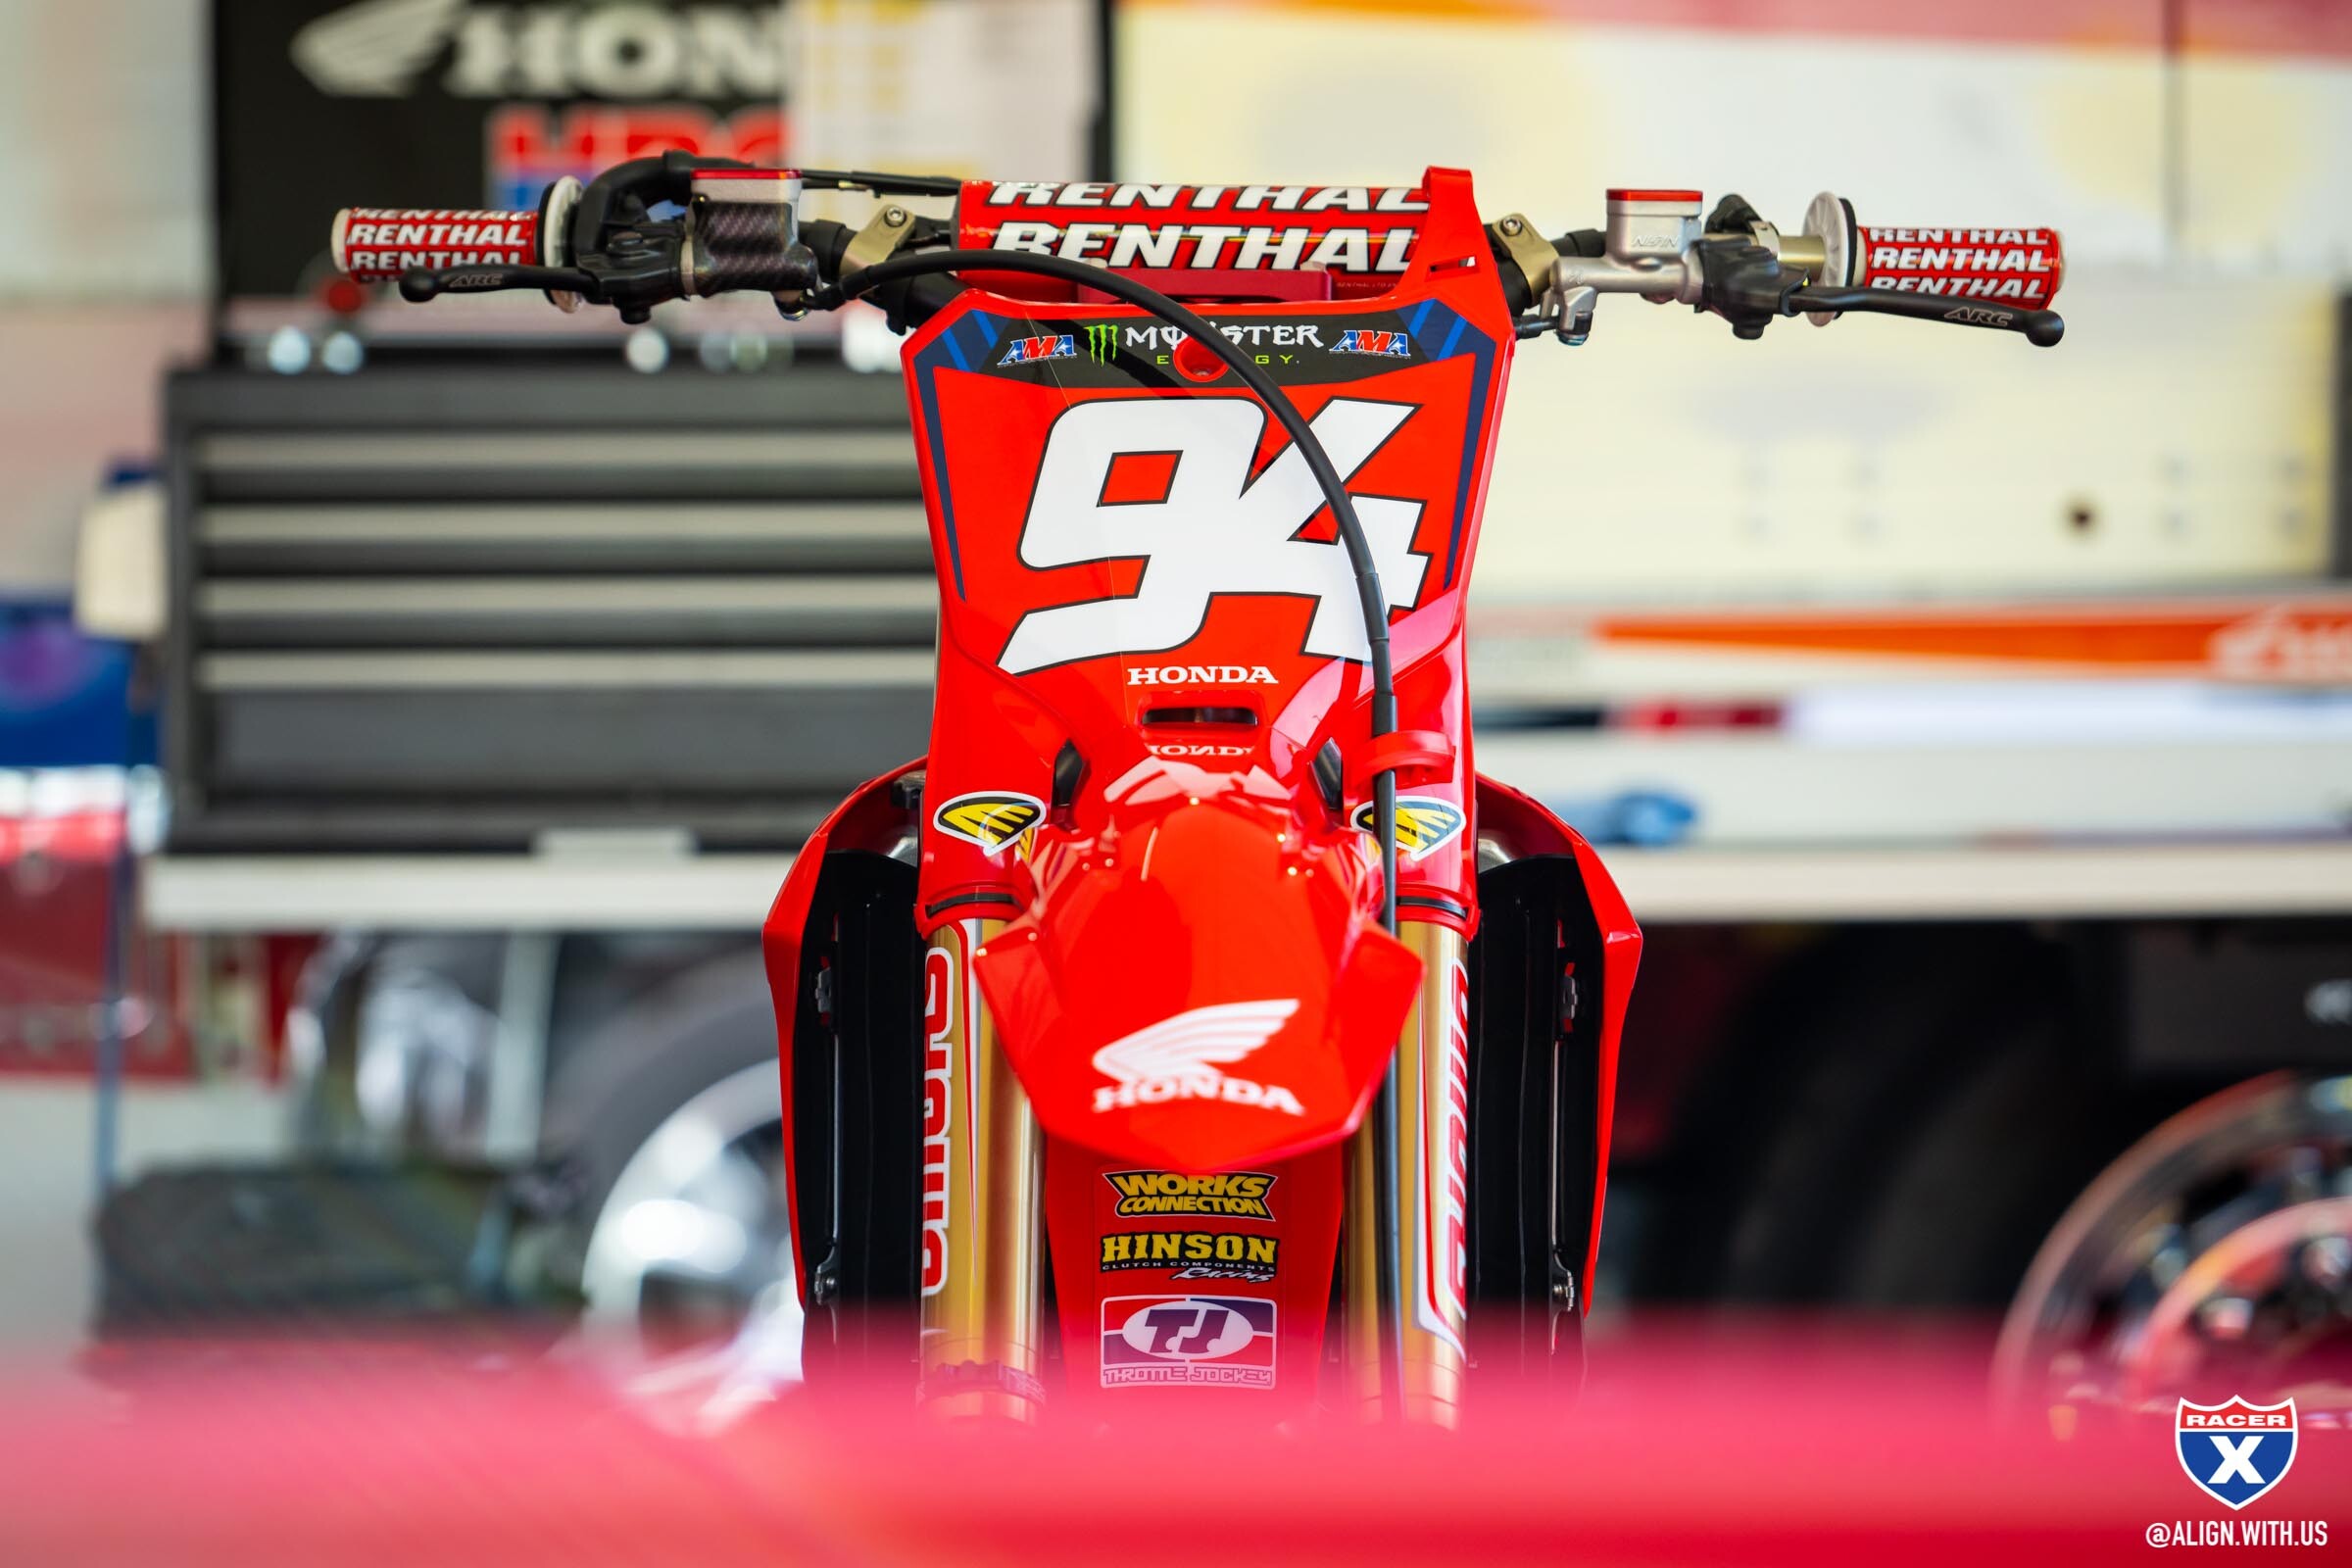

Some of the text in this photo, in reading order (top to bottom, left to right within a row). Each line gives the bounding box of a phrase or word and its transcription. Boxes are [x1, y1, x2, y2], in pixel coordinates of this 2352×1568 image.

[988, 182, 1430, 212] RENTHAL
[346, 223, 527, 245] RENTHAL
[992, 221, 1413, 272] RENTHAL
[1872, 246, 2050, 272] RENTHAL
[449, 273, 503, 287] ARC
[1871, 275, 2047, 299] RENTHAL
[1944, 307, 2013, 326] ARC
[1125, 321, 1324, 350] MOSTER
[1329, 329, 1410, 357] AMA
[997, 334, 1077, 366] AMA
[997, 395, 1434, 676] 94
[1127, 666, 1279, 685] HONDA
[1092, 1074, 1305, 1116] HONDA
[1112, 1173, 1270, 1198] WORKS
[1119, 1197, 1267, 1216] CONNECTION
[1102, 1234, 1277, 1263] HINSON
[1102, 1261, 1275, 1272] CLUTCH COMPONENTS
[1145, 1308, 1230, 1354] TJ
[1104, 1367, 1272, 1387] THROTTLE JOCKEY
